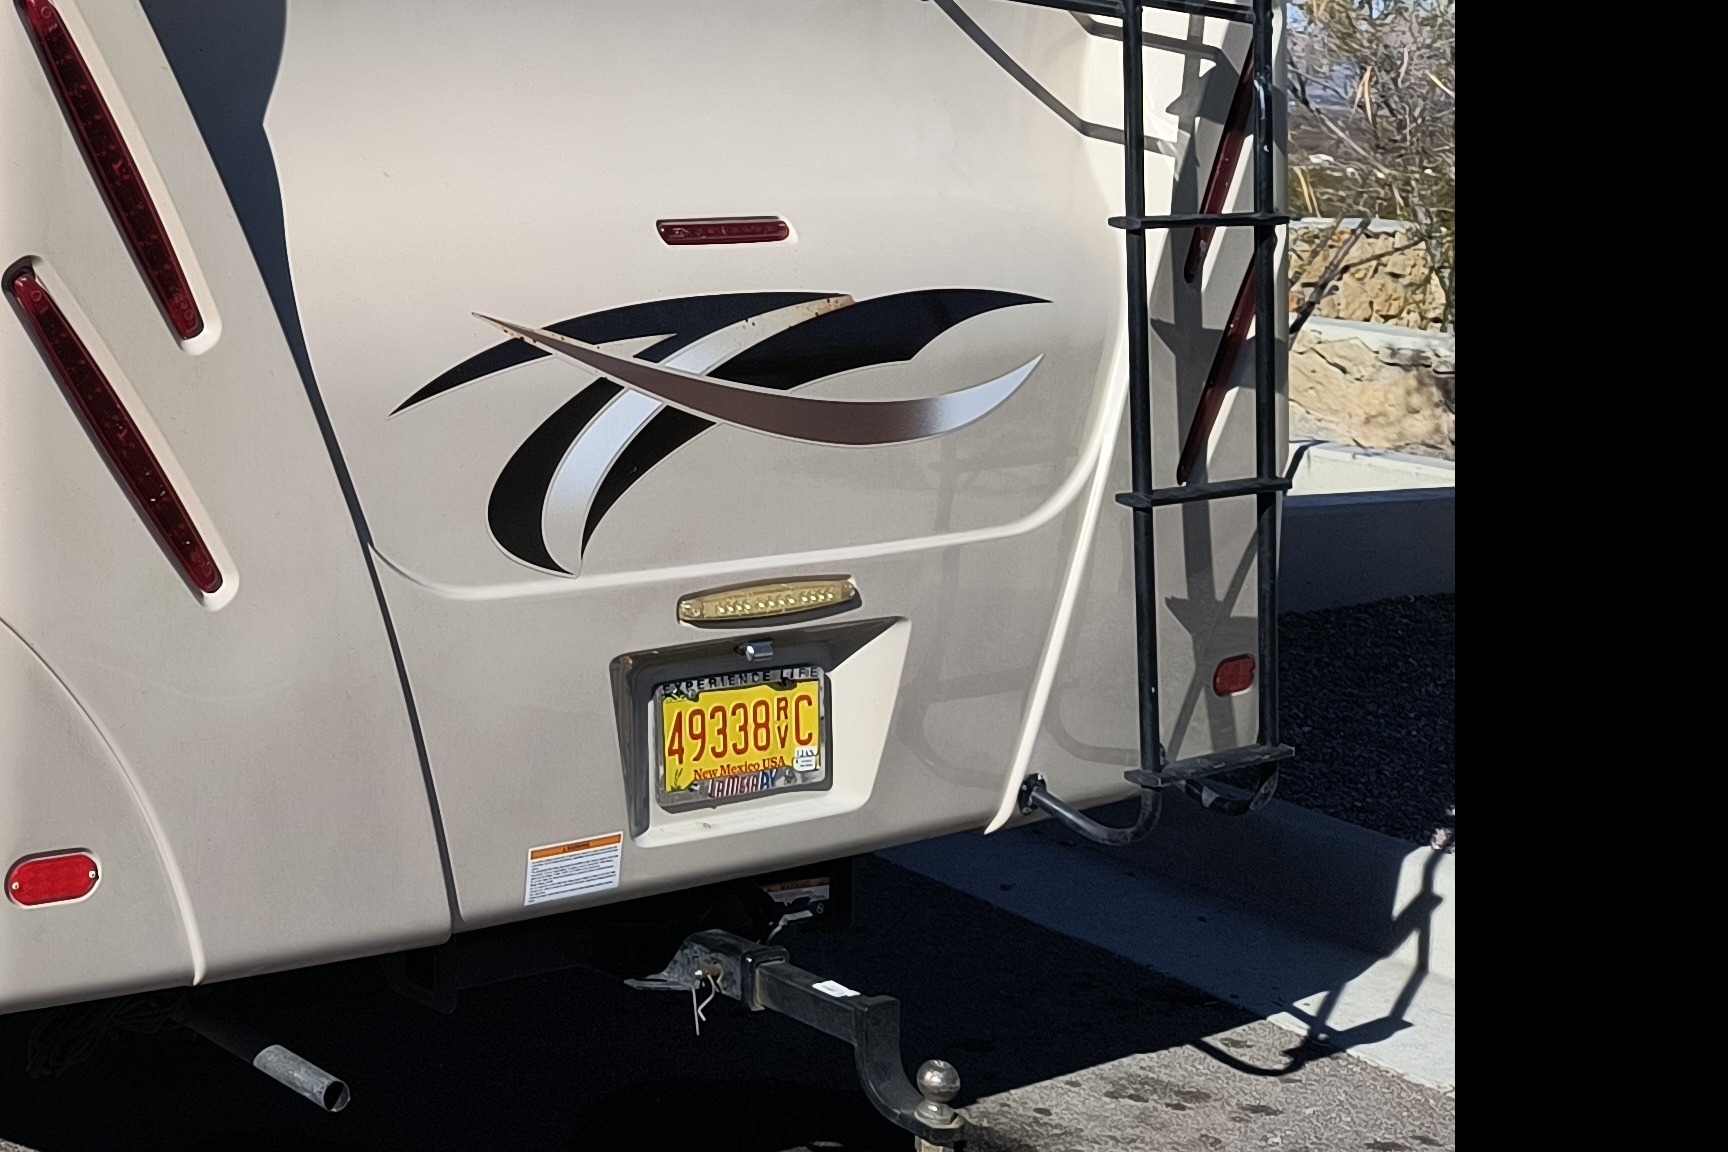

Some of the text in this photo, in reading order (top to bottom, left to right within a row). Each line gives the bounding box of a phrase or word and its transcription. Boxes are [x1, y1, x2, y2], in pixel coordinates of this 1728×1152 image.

[662, 666, 819, 695] EXPERIENCE LIFE
[693, 768, 718, 781] New
[720, 761, 760, 778] Mexico
[762, 755, 786, 769] USA
